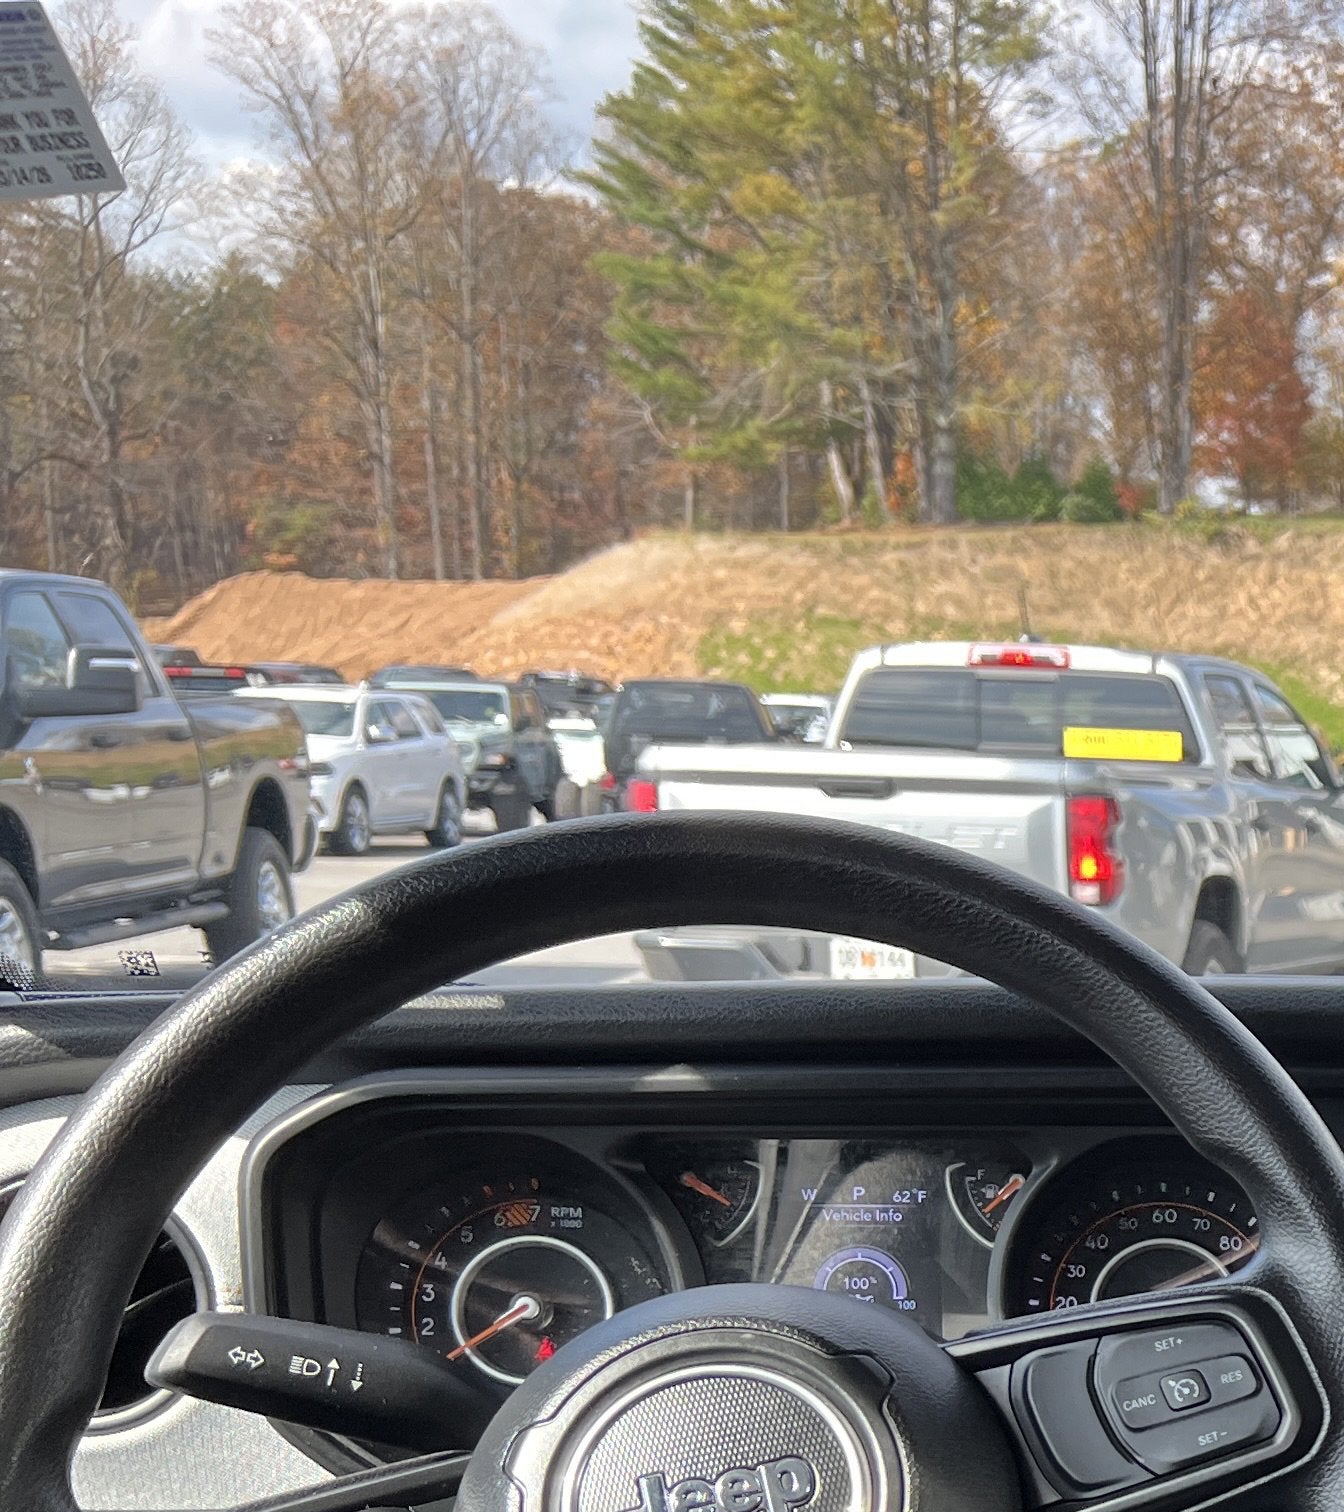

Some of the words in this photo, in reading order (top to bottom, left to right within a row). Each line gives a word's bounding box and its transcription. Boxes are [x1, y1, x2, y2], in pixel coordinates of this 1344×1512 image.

[853, 1186, 866, 1202] P
[529, 1204, 541, 1222] 7
[551, 1206, 582, 1219] RPM
[823, 1208, 873, 1222] Vehicle
[876, 1207, 903, 1222] Info
[1152, 1208, 1178, 1224] 60
[1192, 1217, 1211, 1232] 70
[1085, 1233, 1109, 1251] 40
[1219, 1235, 1242, 1252] 80
[434, 1251, 448, 1271] 4
[1067, 1264, 1086, 1279] 30
[421, 1283, 436, 1303] 3
[421, 1317, 436, 1337] 2
[1220, 1369, 1244, 1385] RES
[1122, 1394, 1157, 1412] CANC
